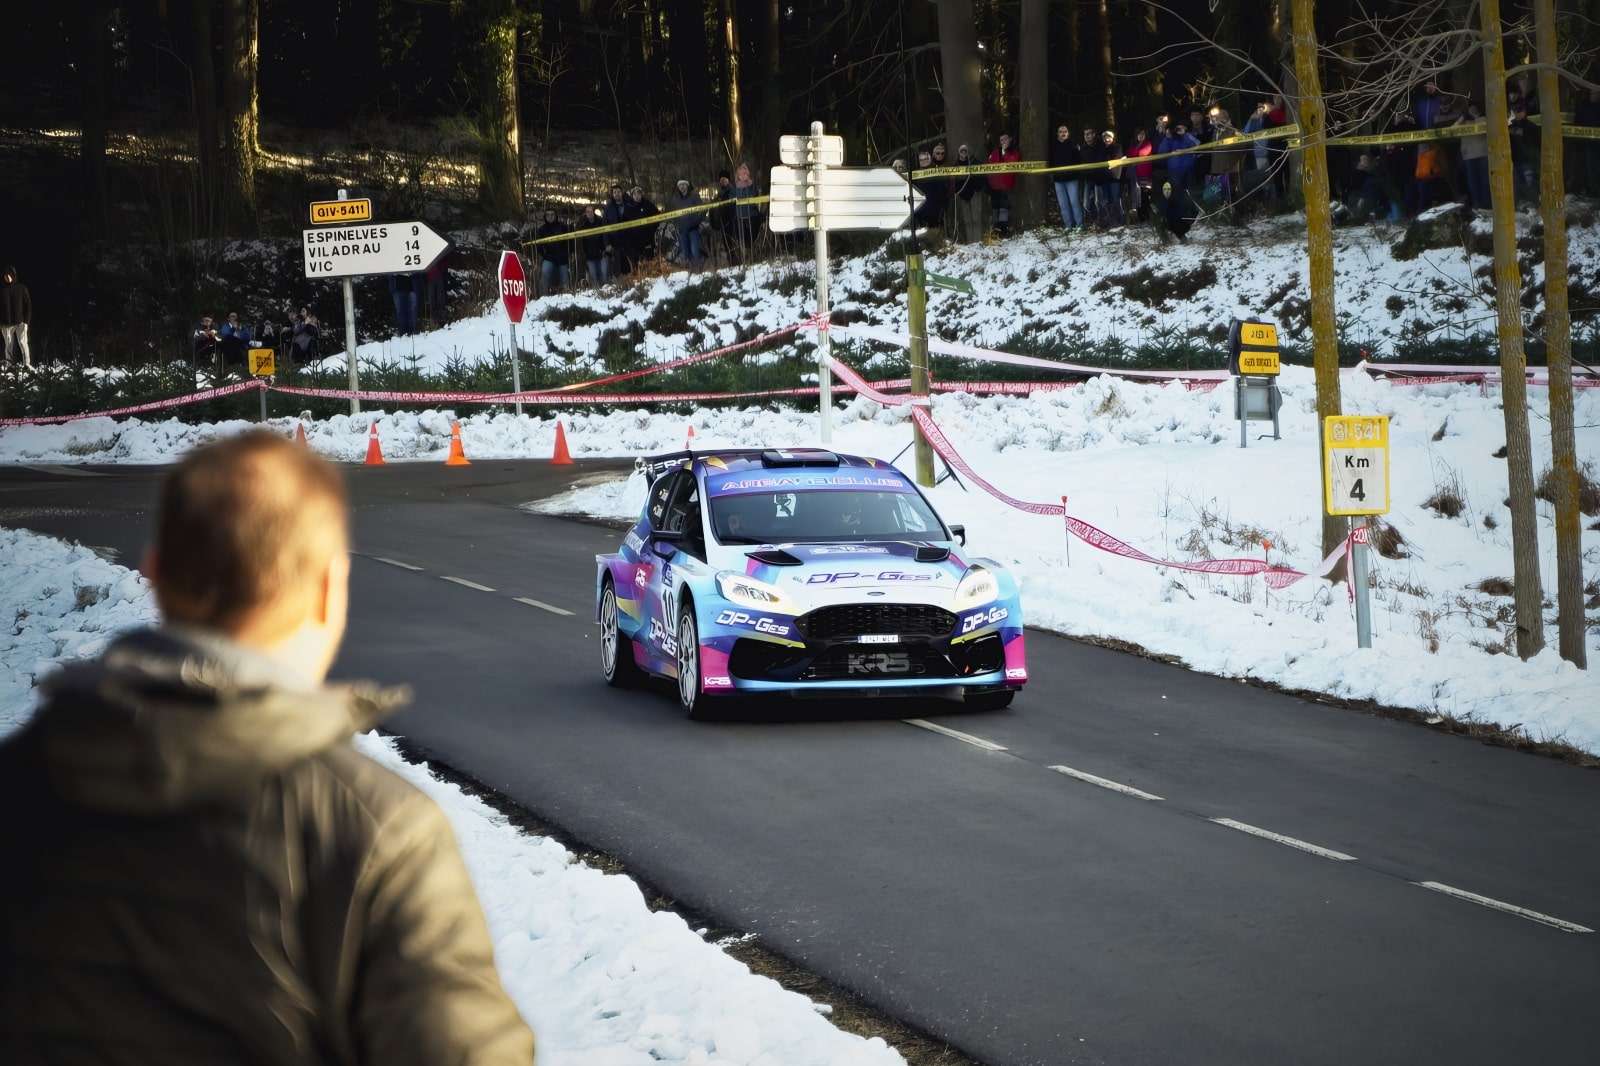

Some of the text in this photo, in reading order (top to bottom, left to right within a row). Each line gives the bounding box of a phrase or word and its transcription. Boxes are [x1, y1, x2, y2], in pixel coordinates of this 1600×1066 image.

[317, 205, 365, 217] GIV-5411
[307, 225, 420, 243] ESPINELVES 9
[308, 240, 420, 258] VILADRAU 14
[309, 254, 421, 273] VIC 25
[503, 278, 524, 297] STOP
[1345, 455, 1370, 468] Km
[1349, 478, 1366, 502] 4
